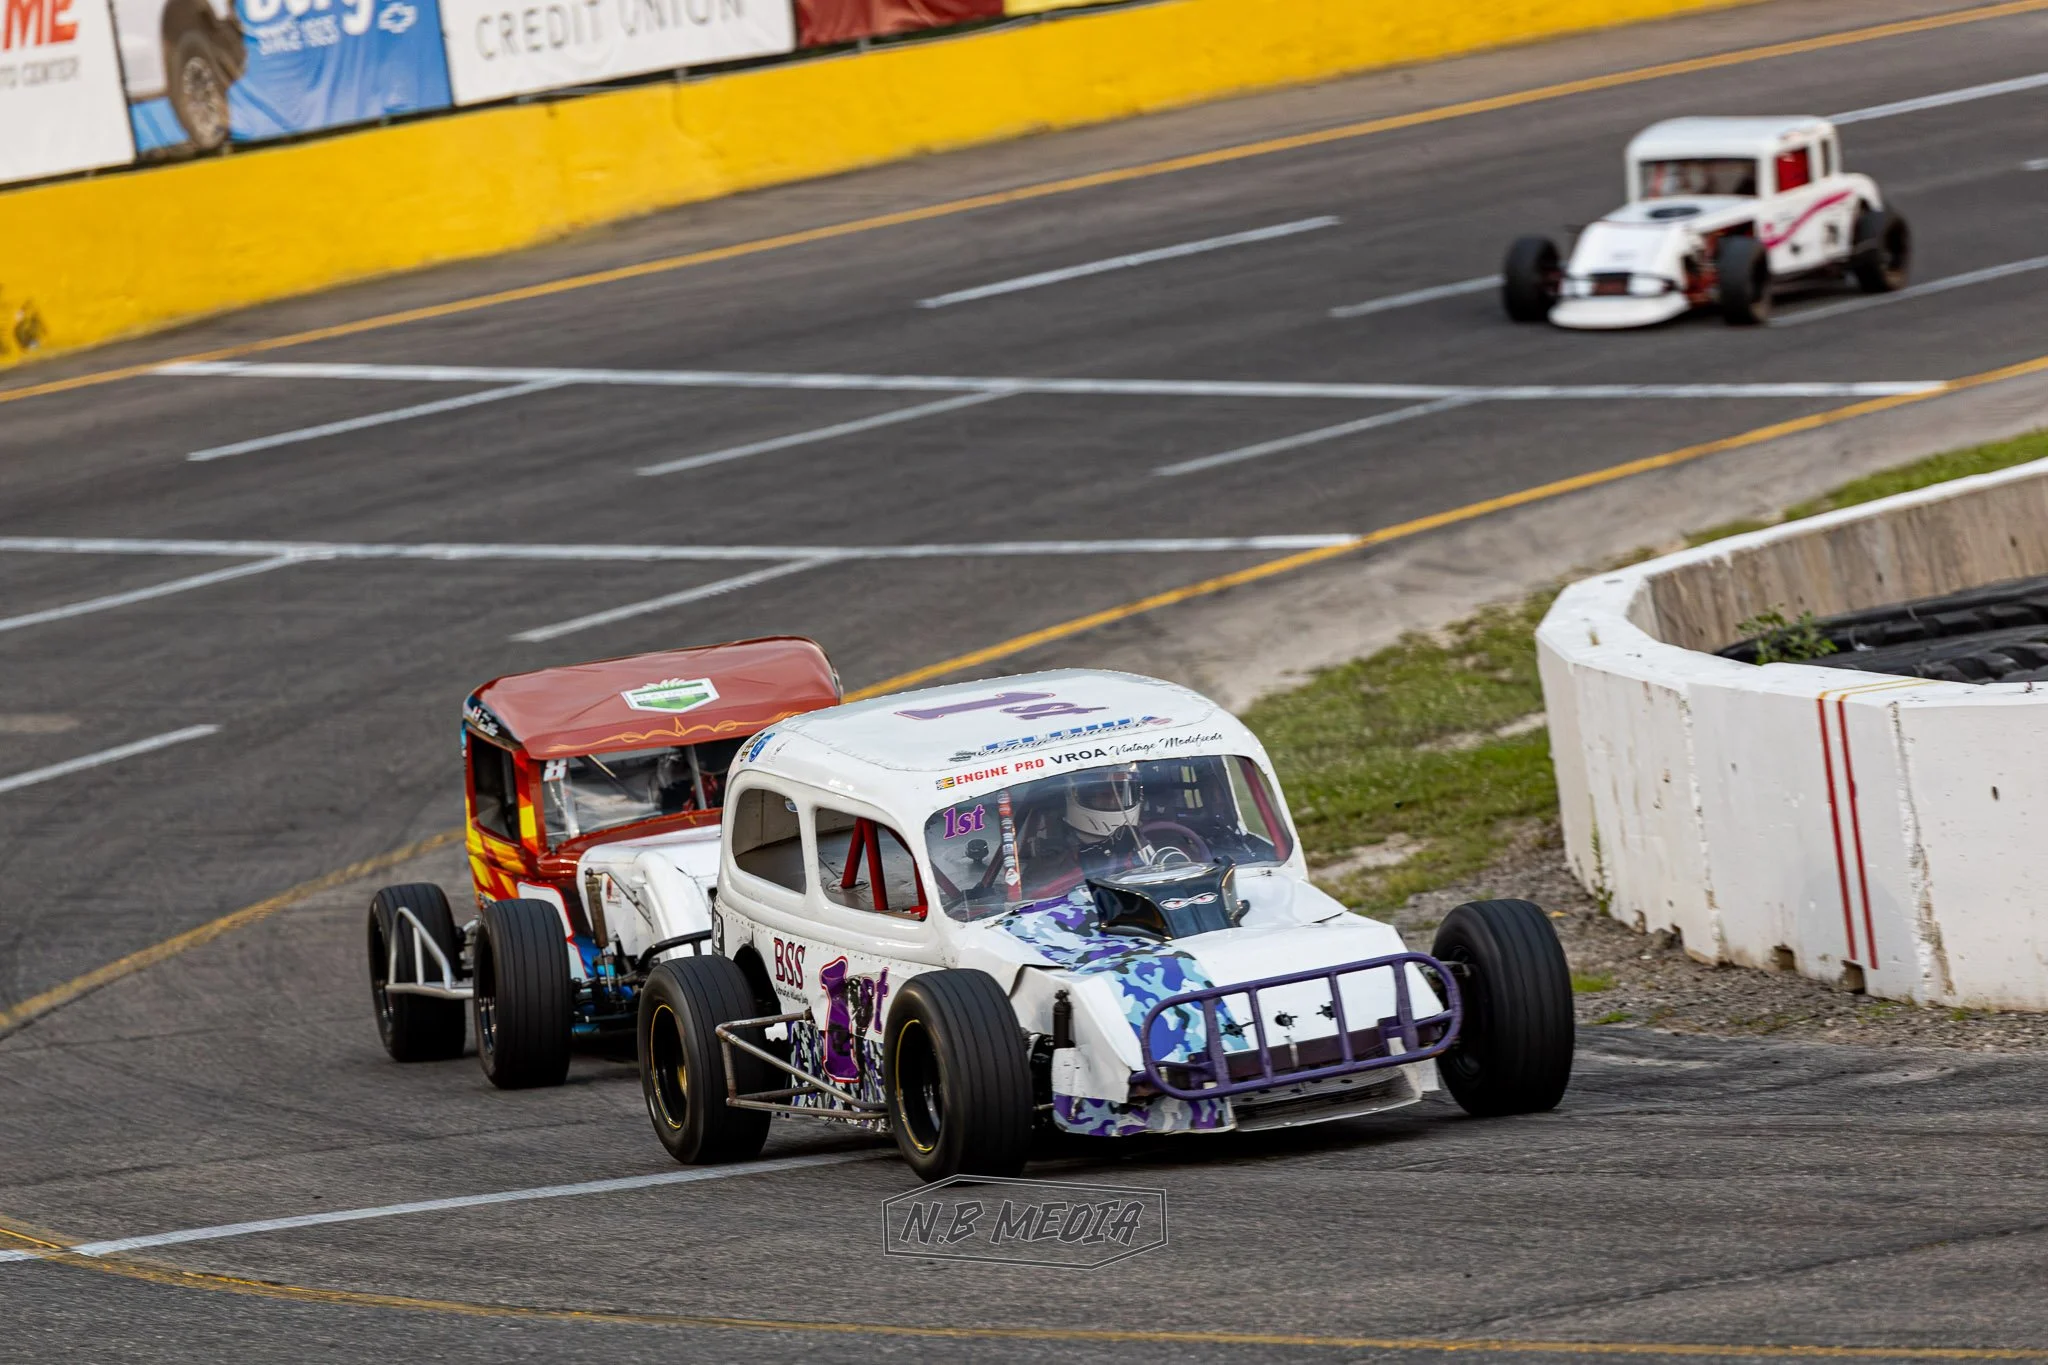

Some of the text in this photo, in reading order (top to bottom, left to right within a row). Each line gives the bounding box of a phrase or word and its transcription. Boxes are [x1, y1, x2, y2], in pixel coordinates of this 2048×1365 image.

[475, 0, 604, 60] CREDIT
[955, 732, 1223, 785] ENGINE PRO VROA Vintage Modifieds
[943, 804, 986, 840] 1st
[773, 936, 806, 990] BSS
